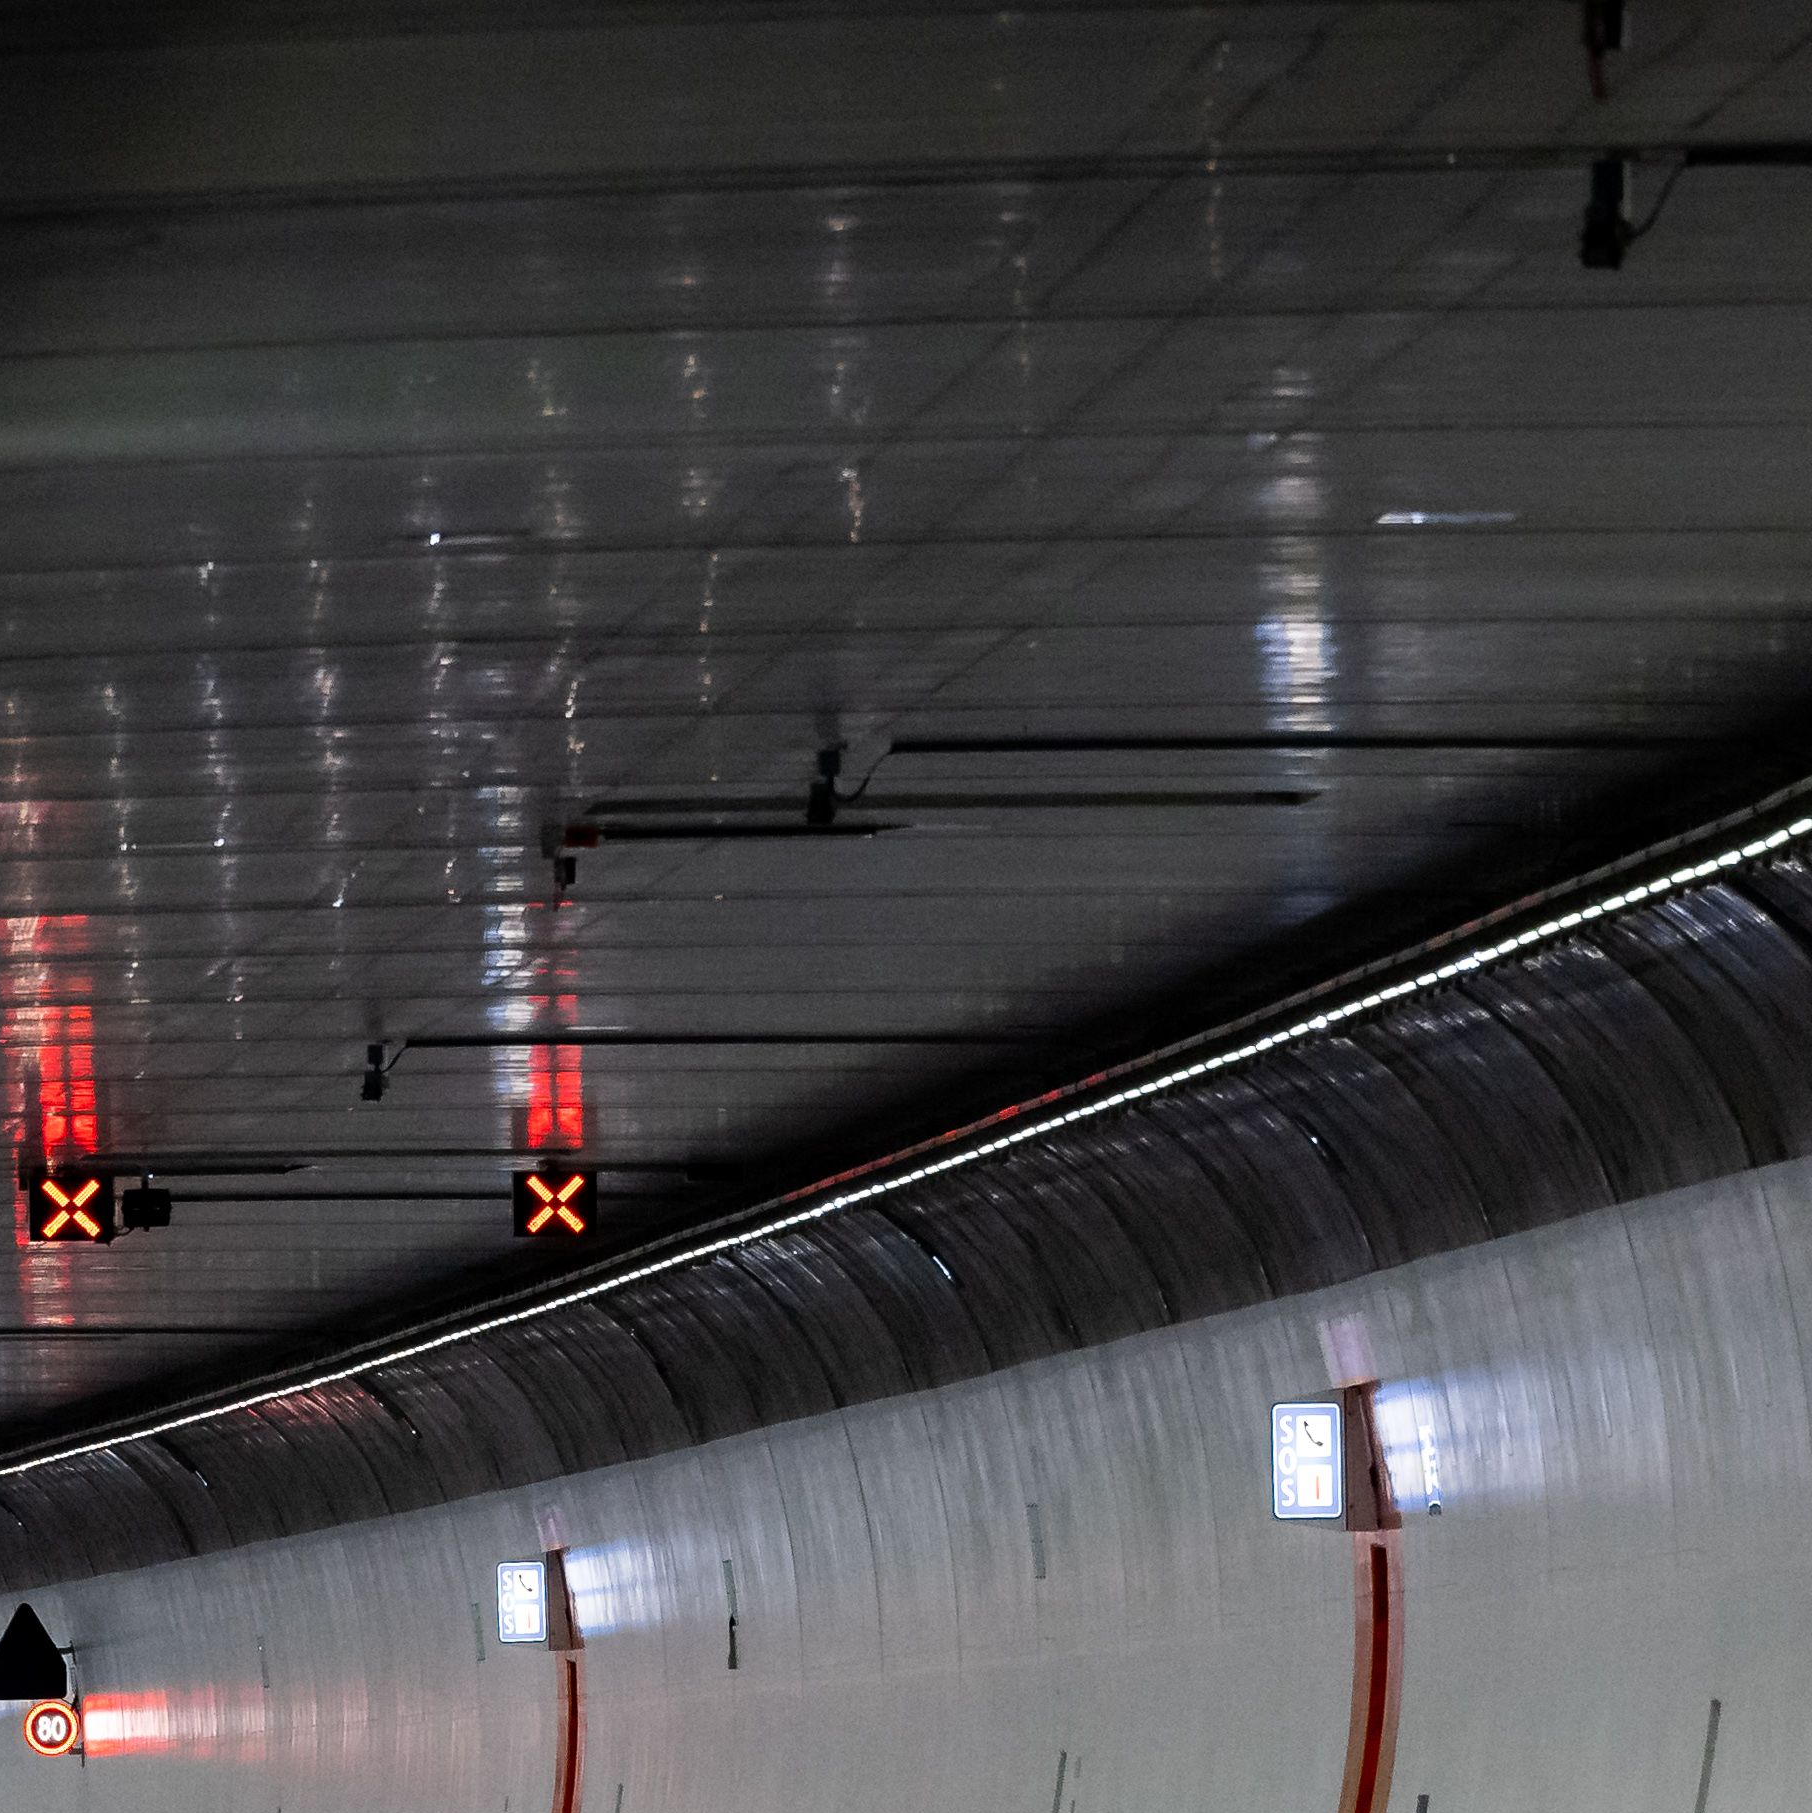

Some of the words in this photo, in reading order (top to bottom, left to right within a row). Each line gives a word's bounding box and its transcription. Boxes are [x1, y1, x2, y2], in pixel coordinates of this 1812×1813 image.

[1277, 1414, 1298, 1508] SOS
[501, 1569, 516, 1635] SOS
[36, 1715, 68, 1742] 80
